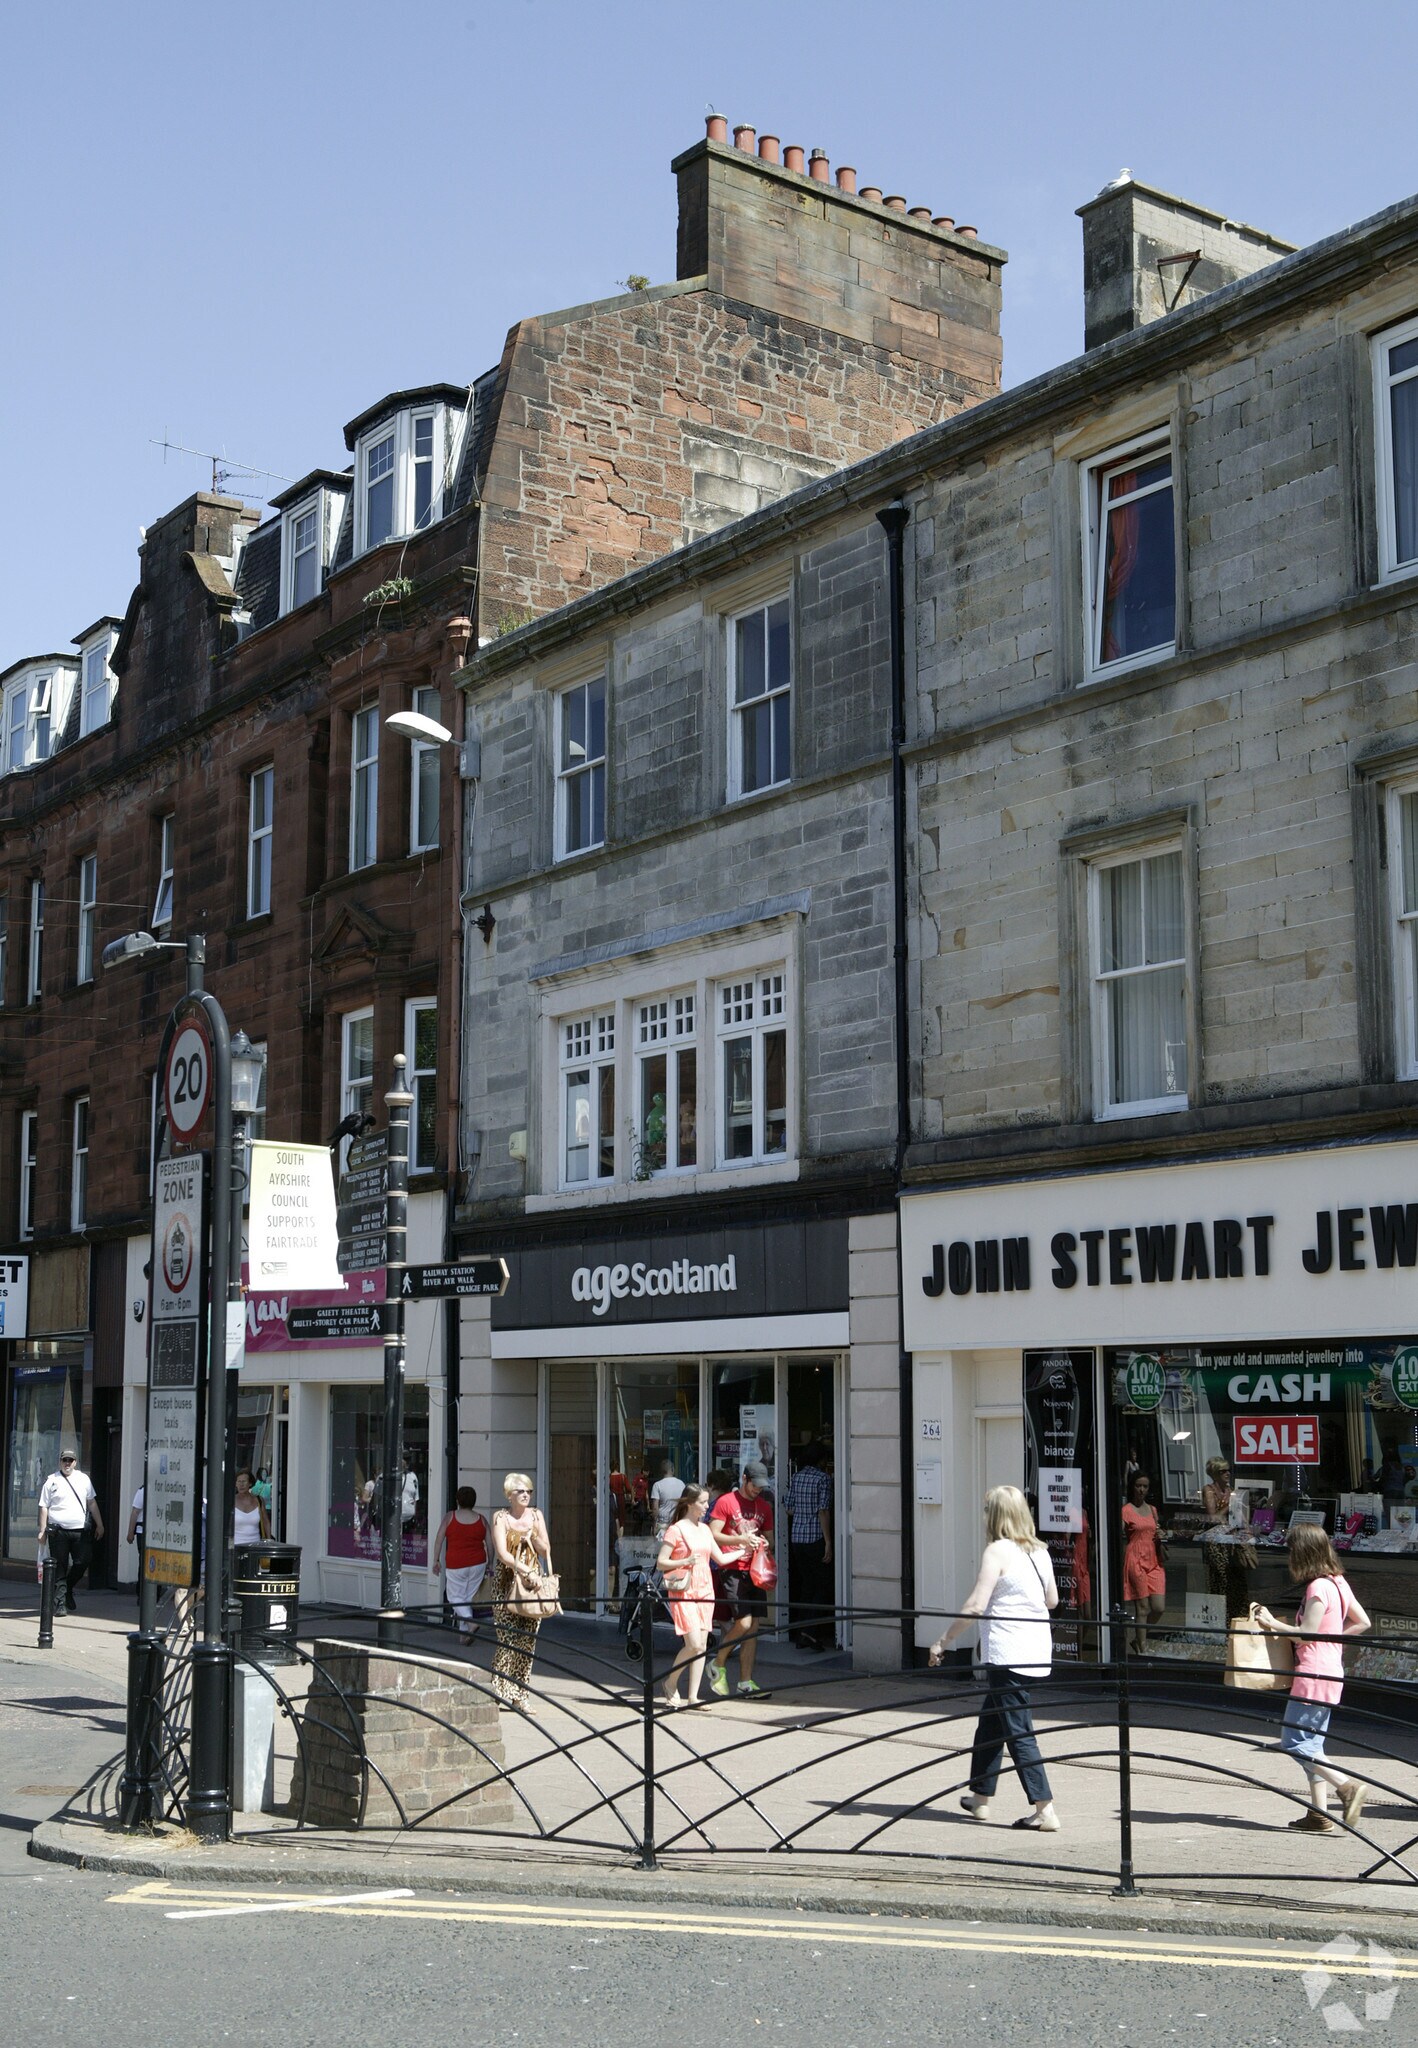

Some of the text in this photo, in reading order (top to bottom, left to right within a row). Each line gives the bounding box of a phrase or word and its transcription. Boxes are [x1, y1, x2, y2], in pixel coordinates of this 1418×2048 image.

[174, 1052, 202, 1104] 20
[276, 1152, 304, 1165] SOUTH
[160, 1159, 200, 1176] PEDESTRIAN
[269, 1172, 310, 1187] AYRSHIRE
[164, 1178, 194, 1203] ZONE
[272, 1194, 308, 1208] COUNCIL
[267, 1215, 316, 1228] SUPPORTS
[266, 1236, 318, 1248] FAIRTRADE
[922, 1203, 1418, 1298] JOHN STEWART JEW
[422, 1266, 476, 1277] RAILWAY STATION
[422, 1276, 474, 1286] RIVER AYR WALK
[456, 1283, 498, 1293] CRAIGIE PARK
[317, 1307, 369, 1317] GAIETY THEATRE
[292, 1316, 369, 1328] MULTI-STOREY CAR PARK
[328, 1326, 370, 1335] BUS STATION
[159, 1328, 191, 1352] ZONE
[1196, 1348, 1364, 1370] Turn your old and unwanted jewellery into
[1131, 1362, 1160, 1384] 10%
[1132, 1385, 1160, 1394] EXTRA
[1228, 1374, 1330, 1403] CASH
[152, 1397, 192, 1410] Except buses
[164, 1417, 178, 1428] taxis
[924, 1424, 940, 1436] 264
[150, 1438, 194, 1450] permit holders
[1240, 1424, 1315, 1455] SALE
[1044, 1444, 1074, 1456] bianco
[169, 1460, 180, 1472] and
[154, 1480, 186, 1496] for loading
[1050, 1494, 1068, 1502] BRANDS
[156, 1506, 164, 1520] by
[1050, 1514, 1070, 1522] IN STOCK
[152, 1530, 186, 1544] only in bays
[633, 1550, 651, 1559] Follow
[261, 1584, 296, 1592] LITTER
[1056, 1576, 1077, 1588] UESS
[1380, 1618, 1418, 1630] CASIO
[1052, 1642, 1078, 1652] rgenti
